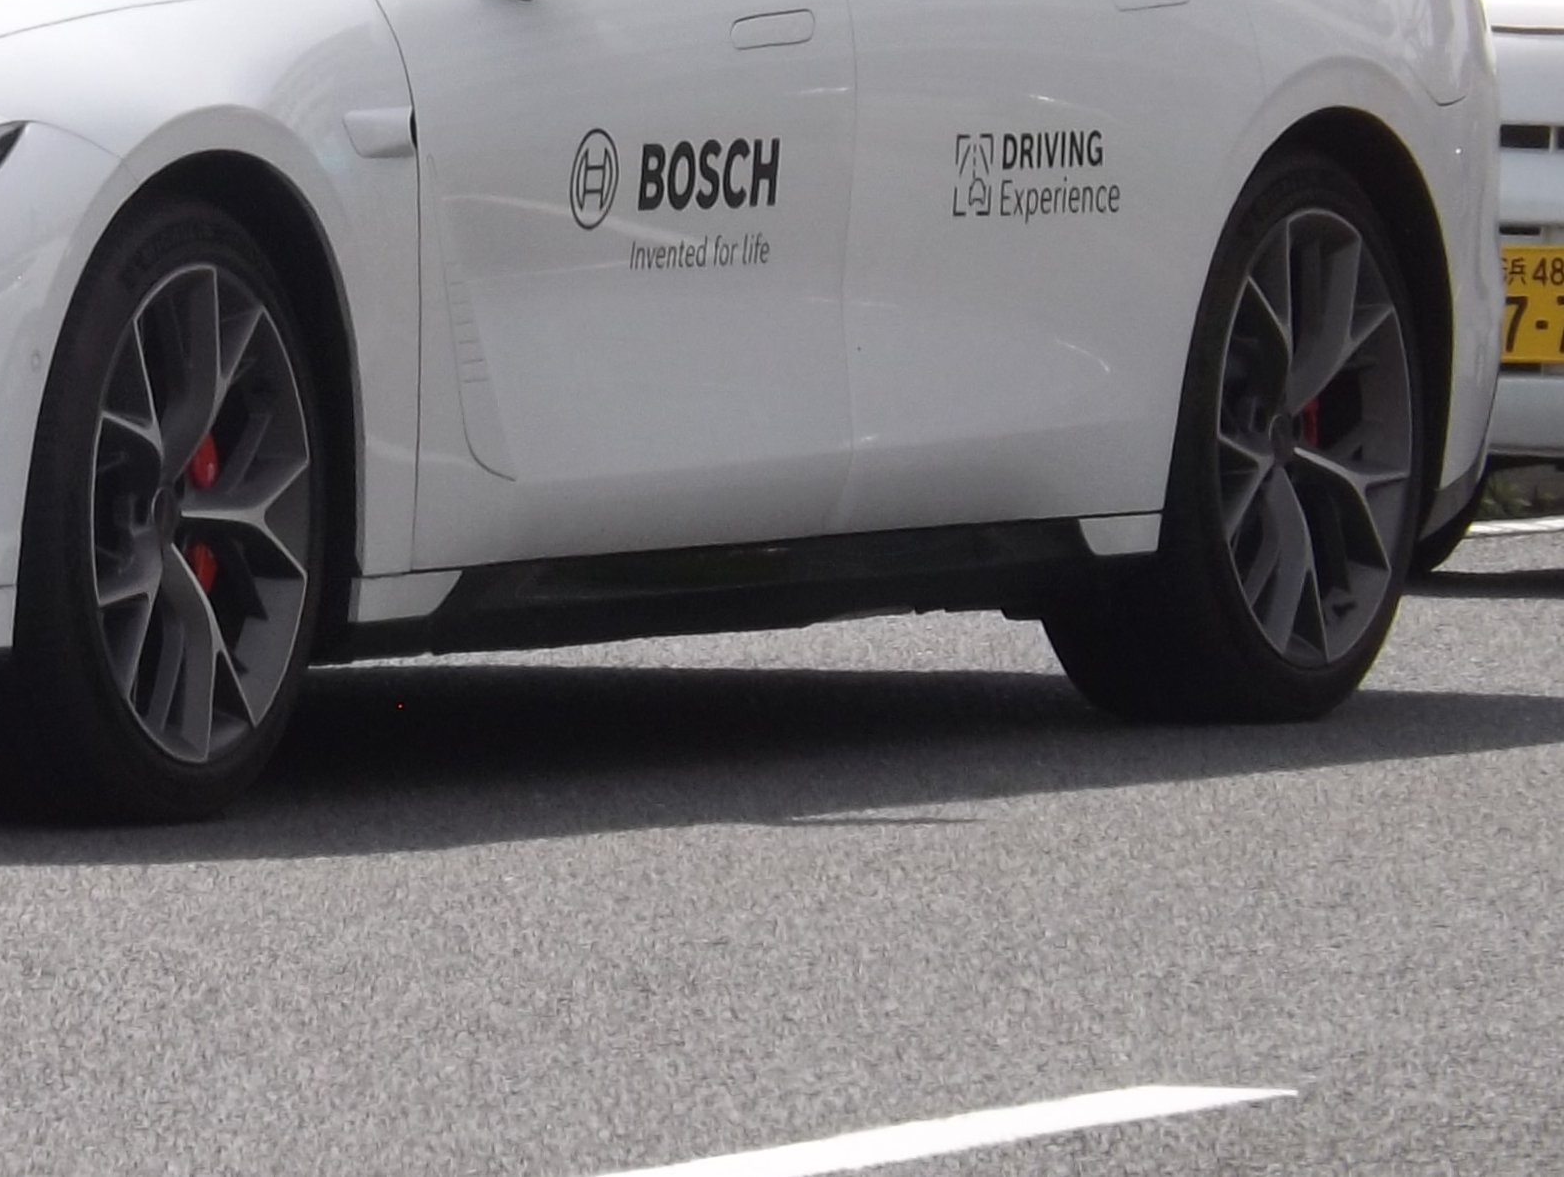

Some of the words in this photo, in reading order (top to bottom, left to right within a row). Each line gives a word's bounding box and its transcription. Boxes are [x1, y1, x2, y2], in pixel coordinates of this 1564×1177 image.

[1001, 130, 1104, 170] DRIVING
[637, 137, 780, 212] BOSCH
[999, 176, 1121, 223] Experience
[629, 236, 708, 271] Invented
[712, 235, 738, 266] for
[742, 231, 770, 266] life
